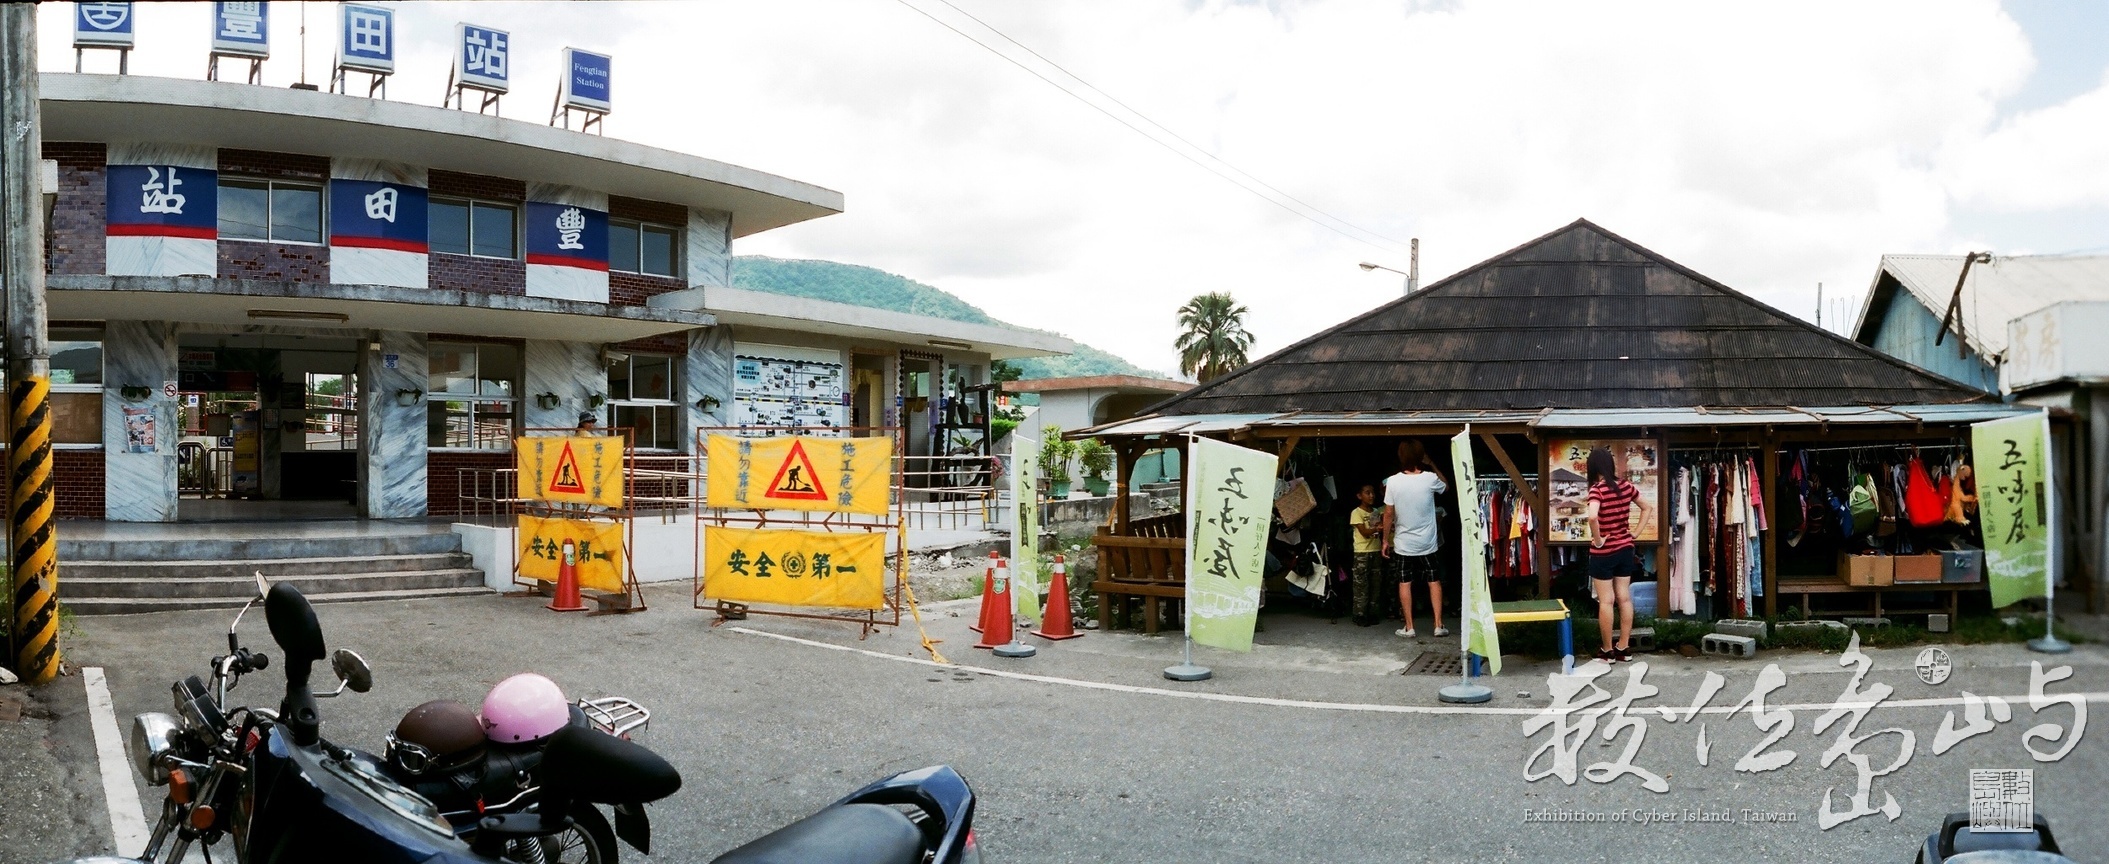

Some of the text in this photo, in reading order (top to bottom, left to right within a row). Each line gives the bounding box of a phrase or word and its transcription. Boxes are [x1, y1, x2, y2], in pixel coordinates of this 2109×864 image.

[350, 11, 387, 55] 田
[466, 29, 506, 77] 站
[574, 62, 607, 77] Fengtian
[576, 76, 604, 89] Station
[141, 166, 186, 216] 站
[364, 187, 398, 224] 田
[556, 207, 586, 251] 豐
[735, 440, 752, 504] 請勿靠近
[838, 442, 855, 507] 施工危險
[1998, 439, 2029, 545] 五味屋
[531, 536, 607, 563] 安全 第一
[727, 549, 857, 580] 安全 第一
